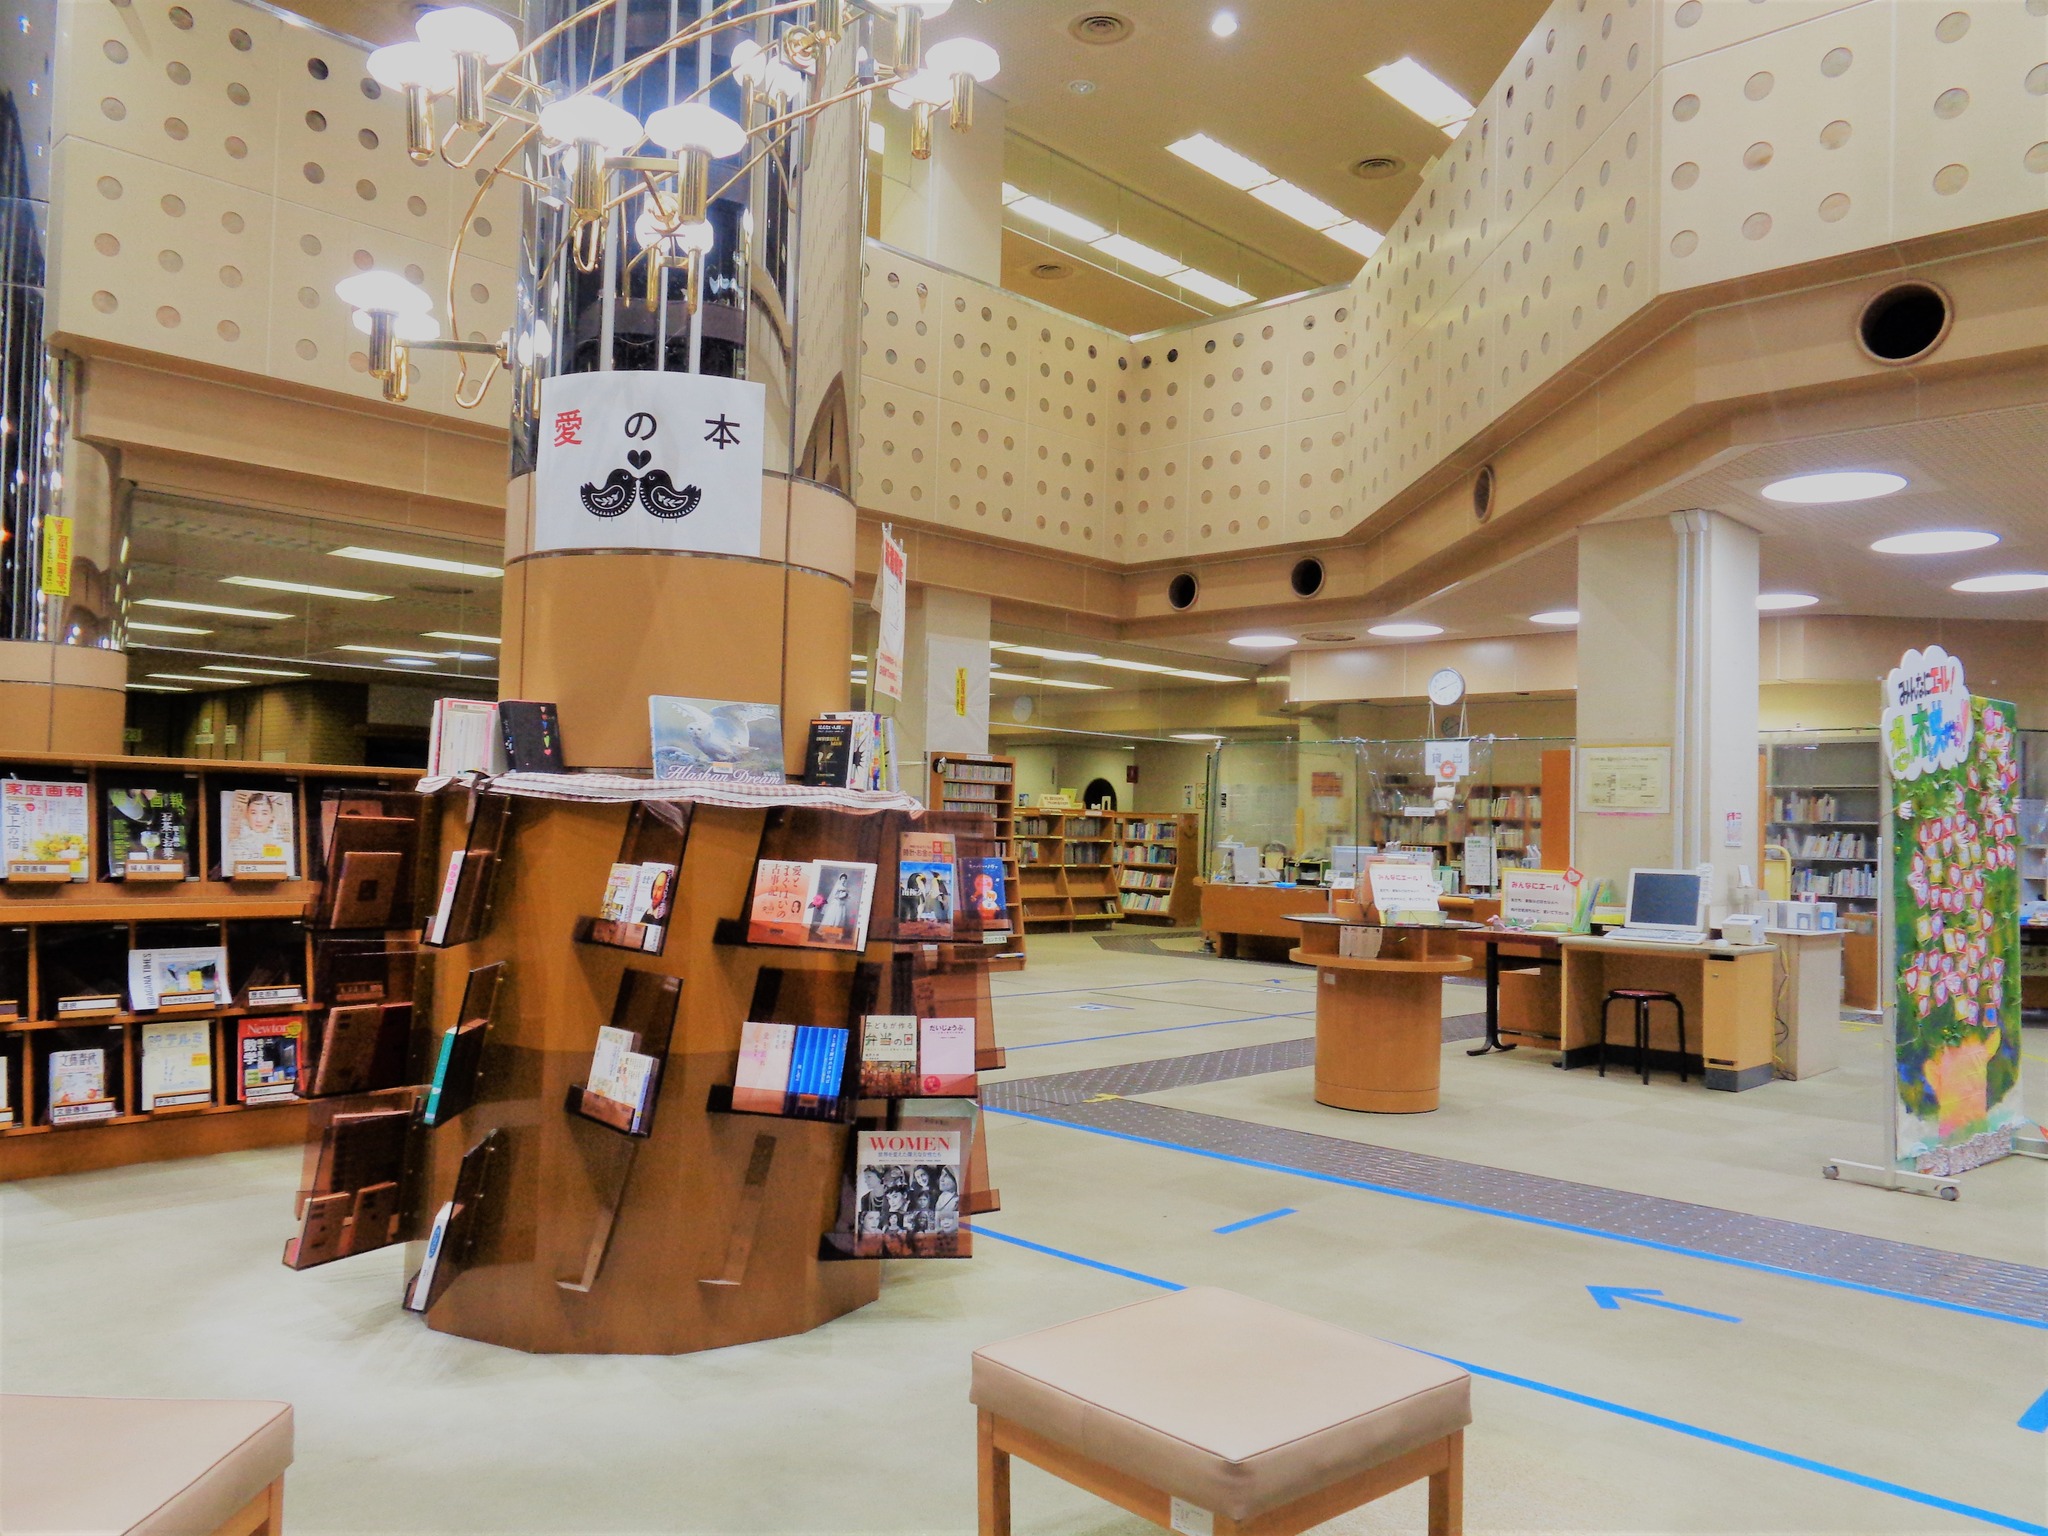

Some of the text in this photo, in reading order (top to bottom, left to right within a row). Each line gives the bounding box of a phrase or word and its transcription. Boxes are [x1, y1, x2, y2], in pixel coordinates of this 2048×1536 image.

[554, 409, 741, 450] 愛の本
[1432, 753, 1463, 764] 貸出
[661, 764, 781, 786] Alaskan Dream
[5, 783, 84, 797] 家庭画報
[237, 793, 283, 805] ミス
[6, 802, 21, 850] 極上の宿
[768, 863, 781, 896] 古事記
[792, 865, 802, 888] 愛と
[143, 953, 152, 973] TIMES
[865, 1021, 913, 1030] 子どもが作る
[166, 1032, 204, 1045] テルミ
[865, 1032, 914, 1046] 弁当の日
[869, 1136, 951, 1152] WOMEN
